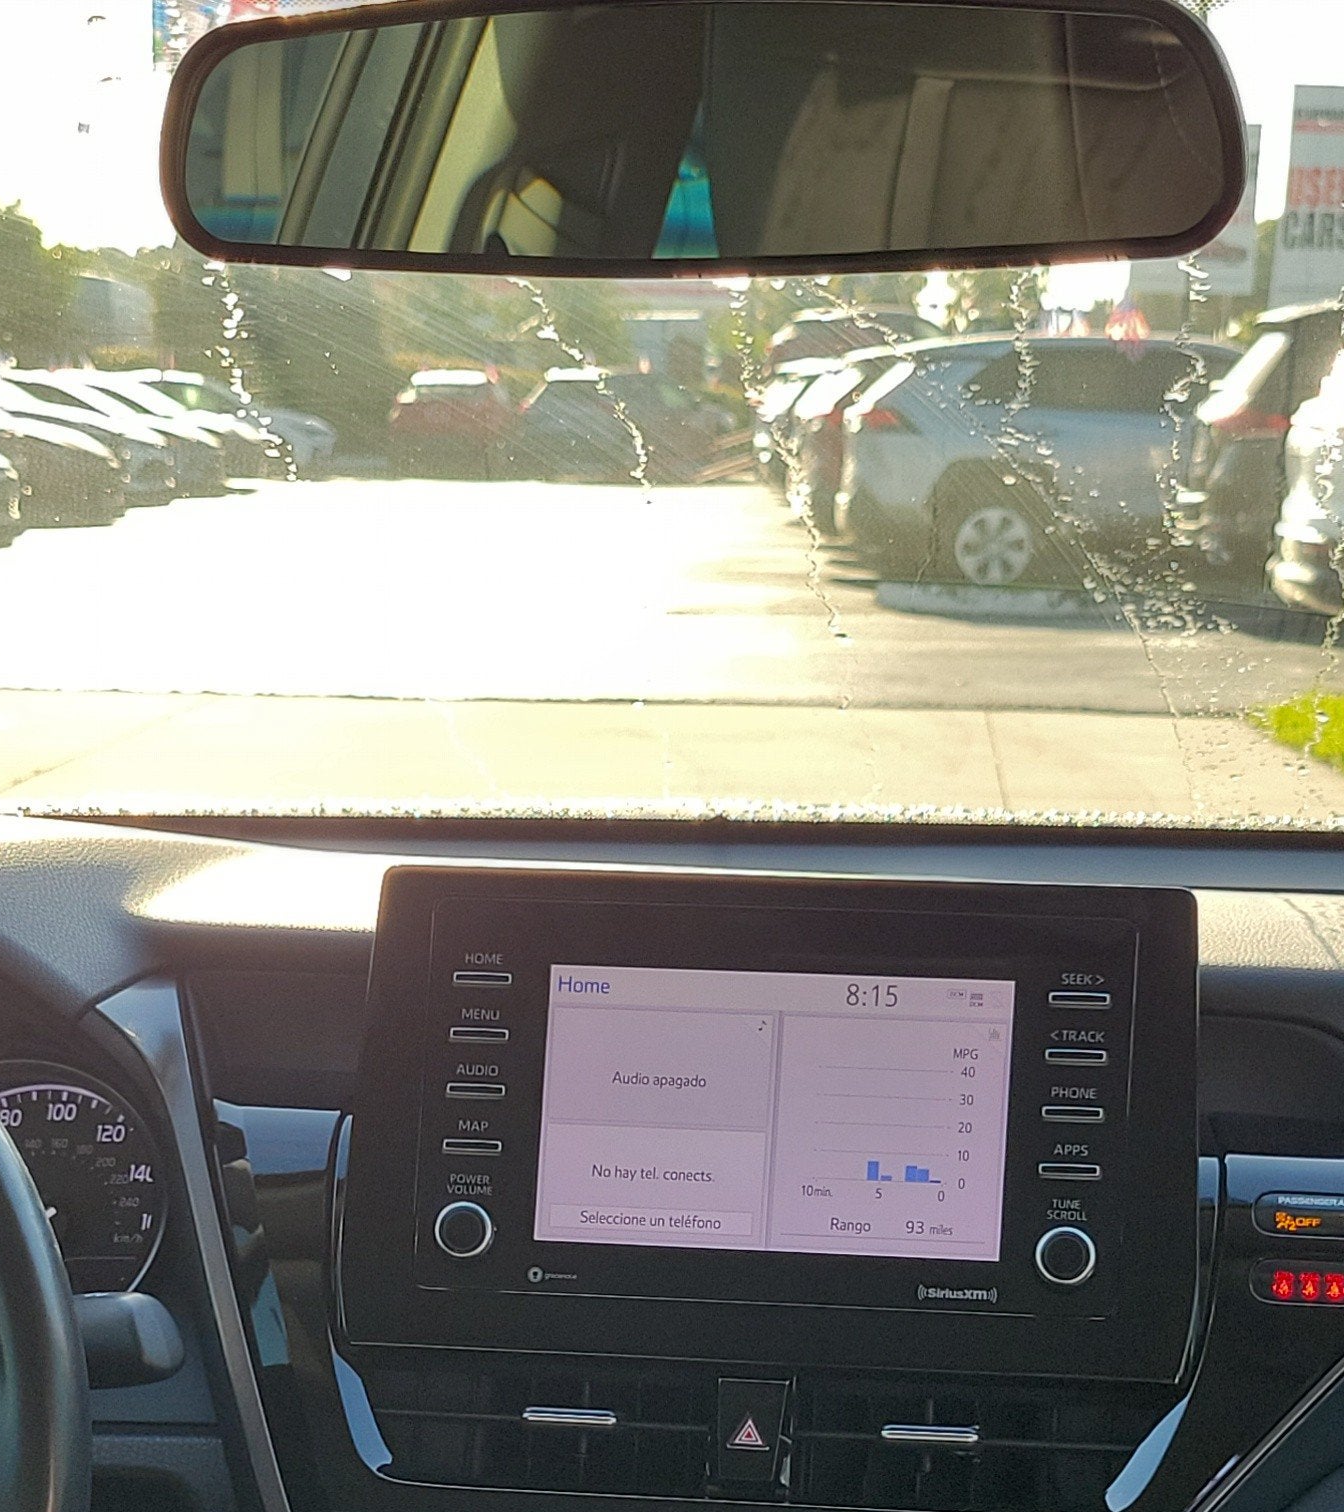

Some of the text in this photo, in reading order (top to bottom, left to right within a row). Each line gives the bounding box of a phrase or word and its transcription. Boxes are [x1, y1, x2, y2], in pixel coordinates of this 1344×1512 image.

[465, 953, 503, 965] HOME
[558, 976, 611, 994] Home
[1061, 973, 1093, 985] SEEK
[846, 983, 898, 1007] 8:15
[461, 1009, 500, 1020] MENU
[1062, 1031, 1105, 1043] TRACK
[953, 1048, 979, 1060] MPG
[456, 1064, 498, 1076] AUDIO
[961, 1066, 976, 1078] 40
[612, 1071, 706, 1090] Audio apagado
[1051, 1087, 1098, 1099] PHONE
[959, 1094, 974, 1106] 30
[46, 1104, 77, 1121] 100
[458, 1120, 489, 1132] MAP
[958, 1122, 973, 1134] 20
[96, 1125, 126, 1142] 120
[957, 1150, 970, 1162] 10
[1053, 1144, 1089, 1157] APPS
[449, 1173, 490, 1185] POWER
[591, 1164, 715, 1183] No hay tel. conects.
[446, 1184, 493, 1196] VOLUME
[958, 1178, 965, 1190] 0
[875, 1188, 883, 1199] 5
[937, 1191, 945, 1202] 0
[1052, 1199, 1081, 1210] TUNE
[580, 1210, 722, 1230] Seleccione un teléfono
[1046, 1209, 1087, 1221] SCROLL
[830, 1217, 953, 1236] Rango 93 miles
[1296, 1217, 1322, 1227] OFF
